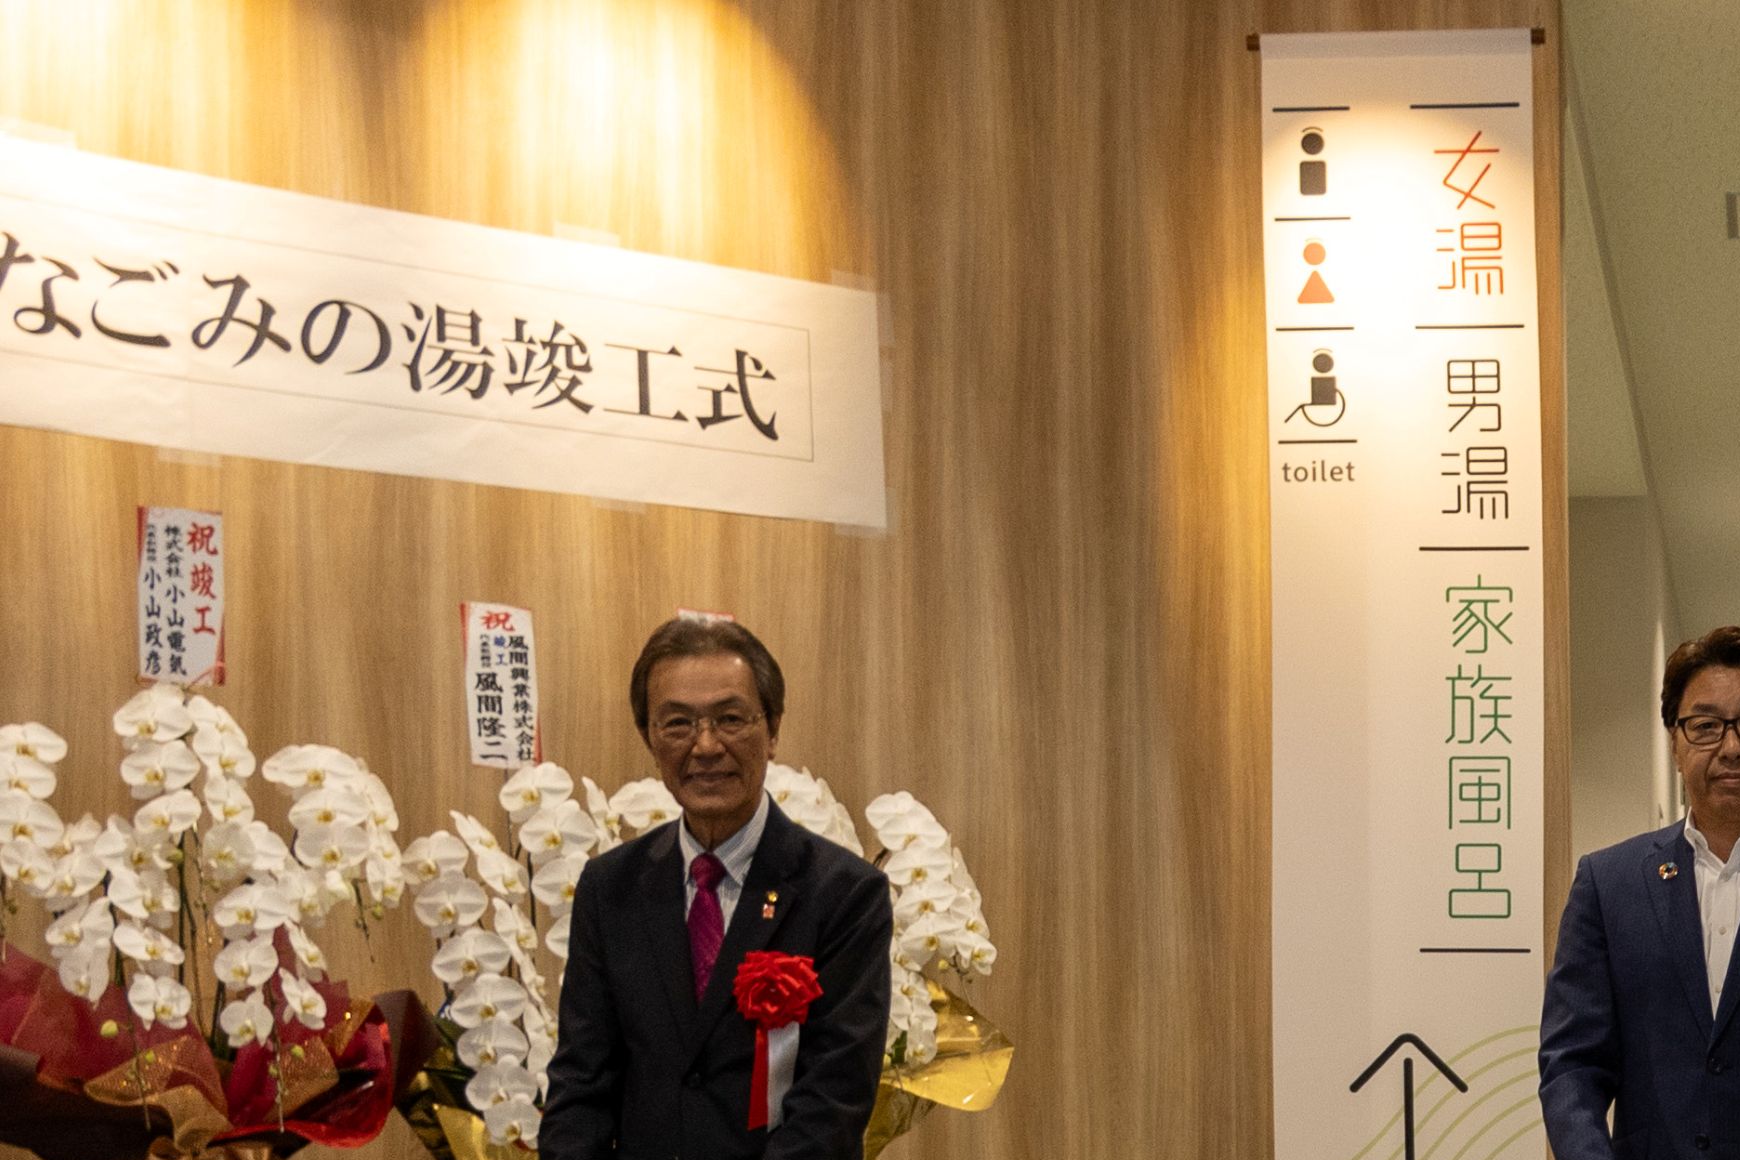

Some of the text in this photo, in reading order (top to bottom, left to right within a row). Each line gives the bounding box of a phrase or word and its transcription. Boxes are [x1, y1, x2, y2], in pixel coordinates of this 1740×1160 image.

[1433, 130, 1504, 296] 女湯
[0, 231, 780, 441] なごみの湯竣工式
[1282, 459, 1355, 482] toilet
[1441, 358, 1510, 520] 男湯
[187, 522, 219, 636] 祝竣工
[480, 611, 515, 632] 祝
[1444, 574, 1514, 920] 家族風呂
